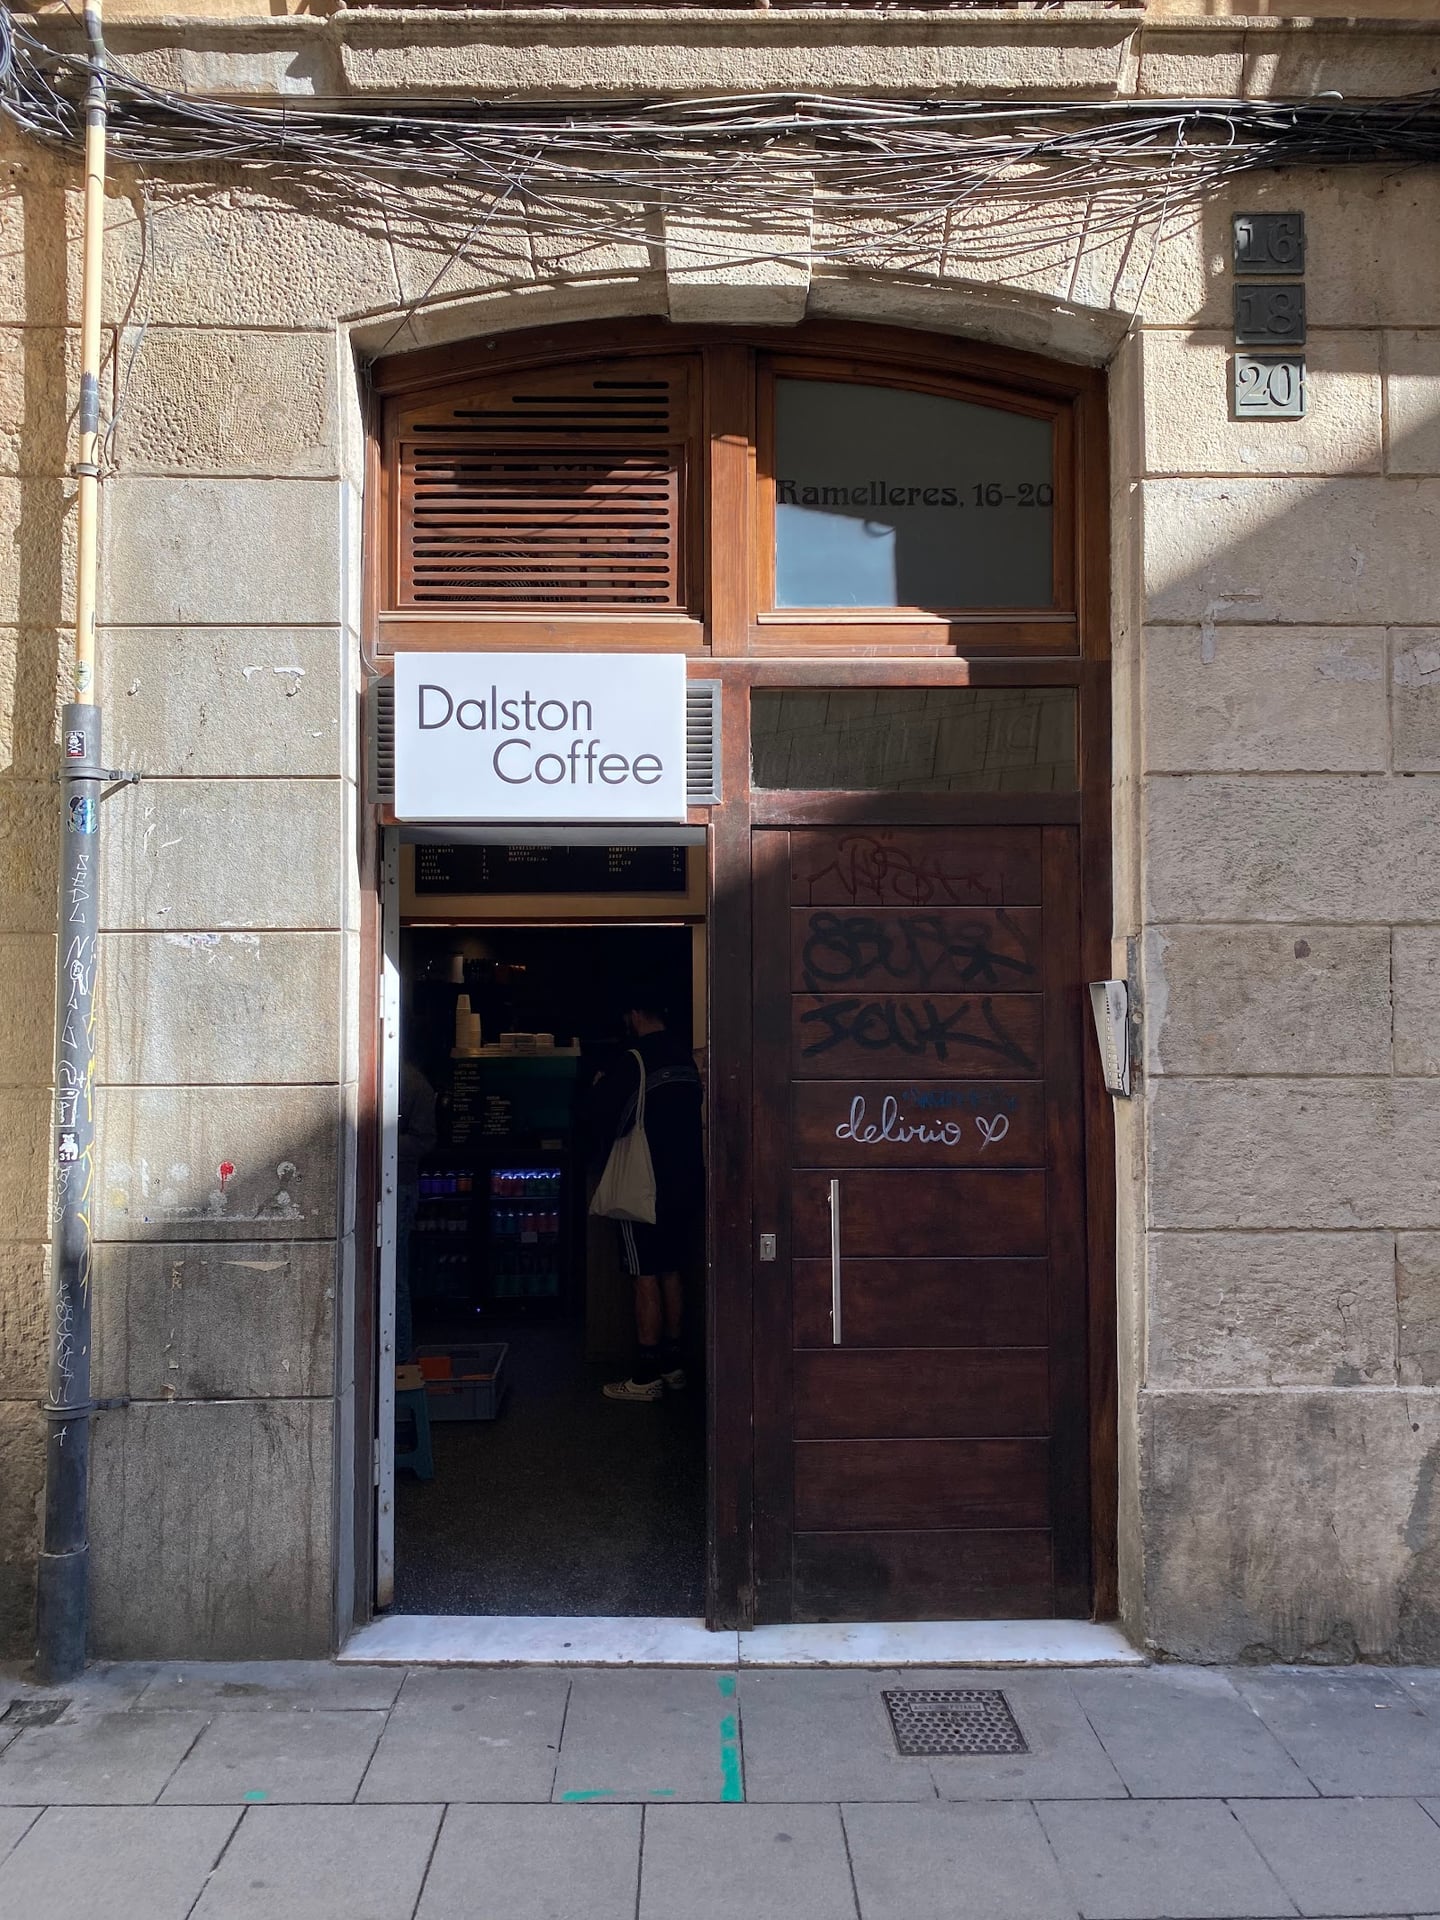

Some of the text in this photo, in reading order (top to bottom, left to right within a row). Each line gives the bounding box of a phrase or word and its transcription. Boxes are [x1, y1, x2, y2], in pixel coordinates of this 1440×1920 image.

[1238, 222, 1299, 263] 16
[1239, 293, 1298, 334] 18
[1238, 362, 1296, 407] 20
[776, 479, 1054, 509] Ramelleres, 16-20
[418, 684, 592, 731] Dalston
[492, 737, 664, 785] Coffee
[835, 1095, 962, 1146] delirio
